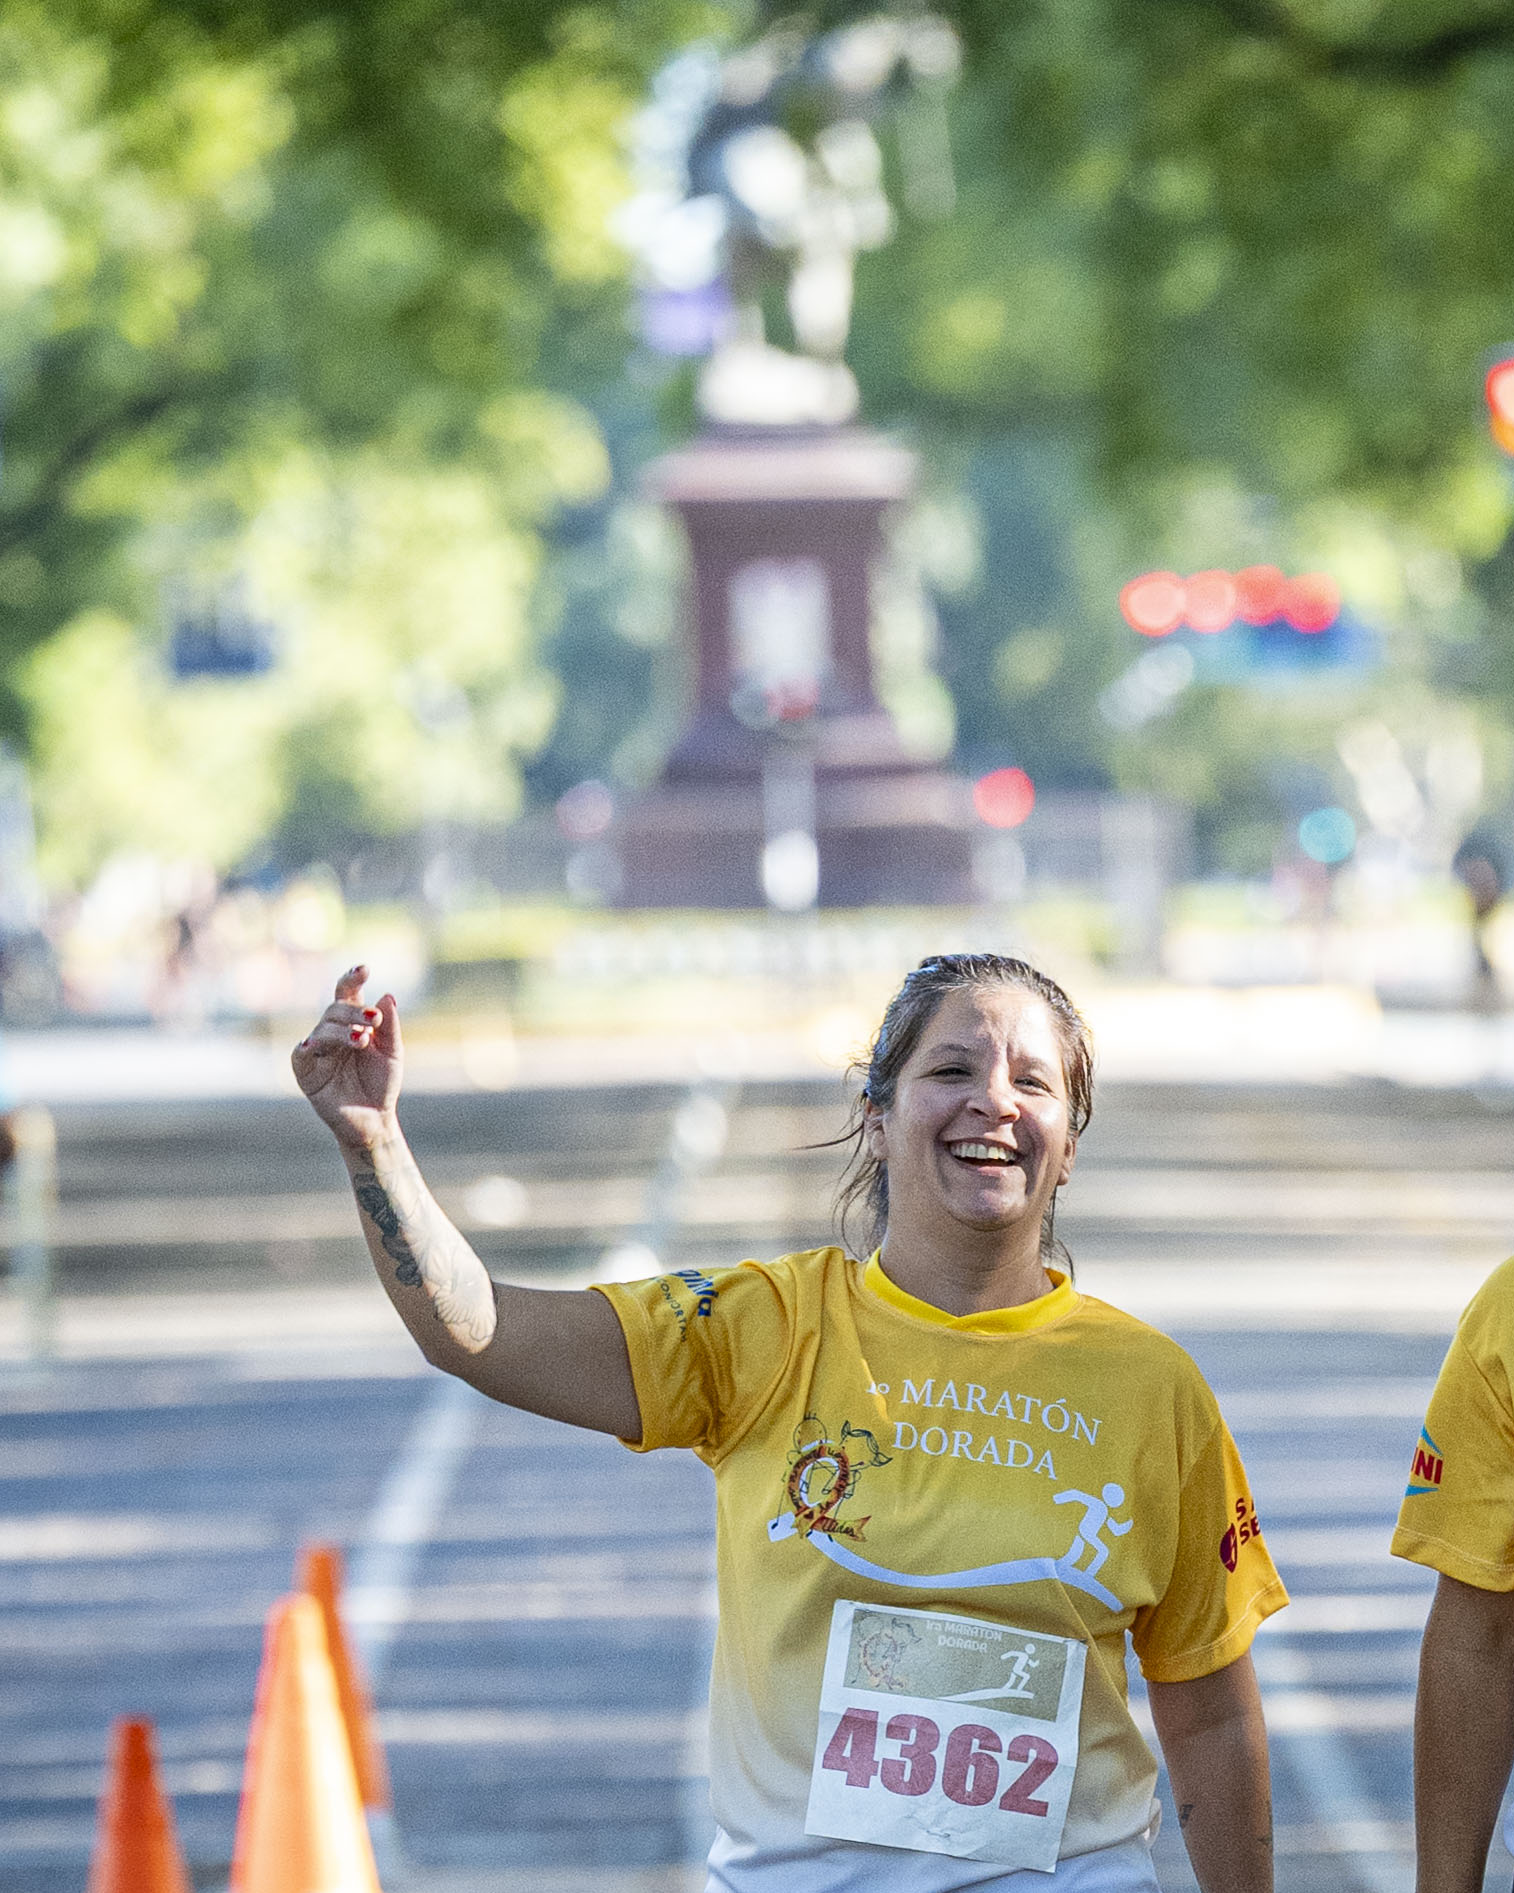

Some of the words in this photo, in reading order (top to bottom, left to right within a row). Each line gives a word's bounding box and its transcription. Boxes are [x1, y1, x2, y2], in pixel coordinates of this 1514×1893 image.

[901, 1378, 1102, 1446] MARATÓN
[892, 1421, 1058, 1480] DORADA
[1411, 1447, 1443, 1484] NI
[938, 1635, 988, 1653] DORADA
[822, 1706, 1059, 1818] 4362
